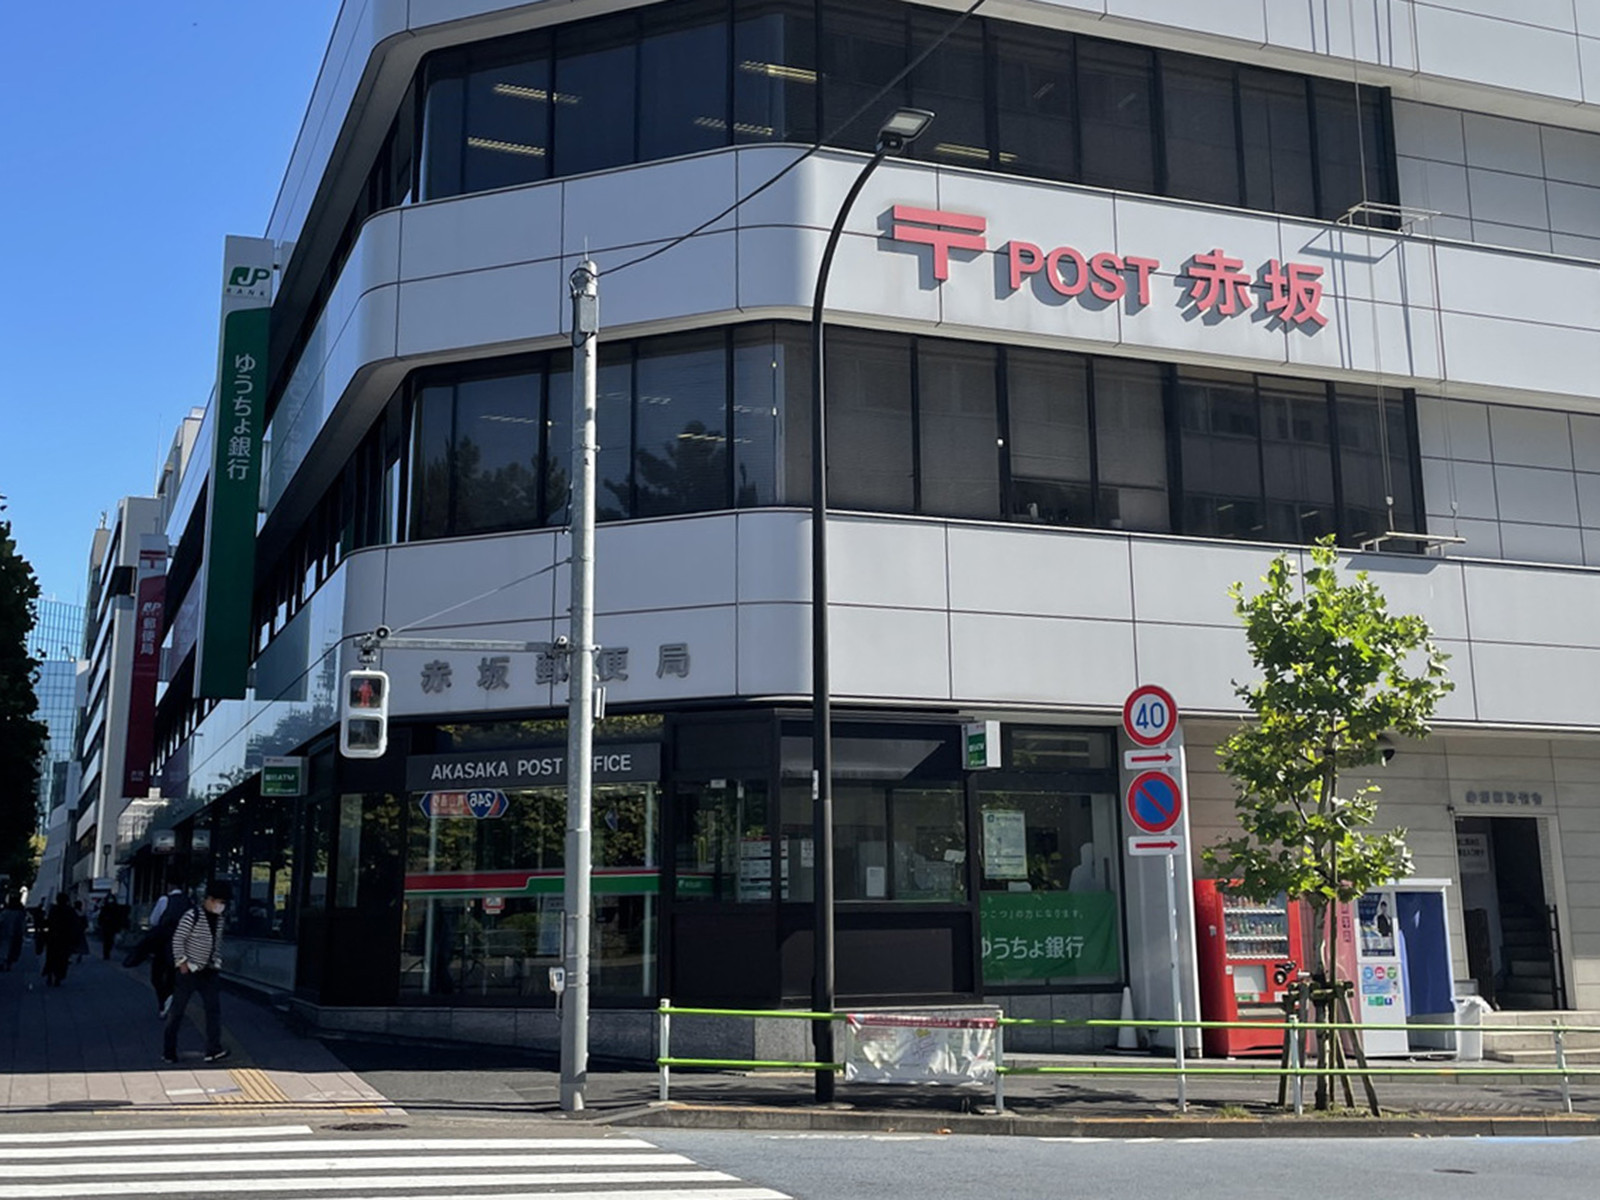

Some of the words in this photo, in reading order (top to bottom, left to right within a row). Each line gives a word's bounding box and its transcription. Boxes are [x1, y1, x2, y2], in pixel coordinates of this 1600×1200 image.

[1008, 240, 1160, 306] POST
[1188, 248, 1329, 328] 赤坂
[226, 353, 256, 480] ゆうちょ銀行
[421, 642, 691, 694] 赤坂郵便局
[1135, 702, 1165, 729] 40
[431, 760, 509, 781] AKASAKA
[517, 757, 563, 777] POST
[592, 754, 632, 772] FICE
